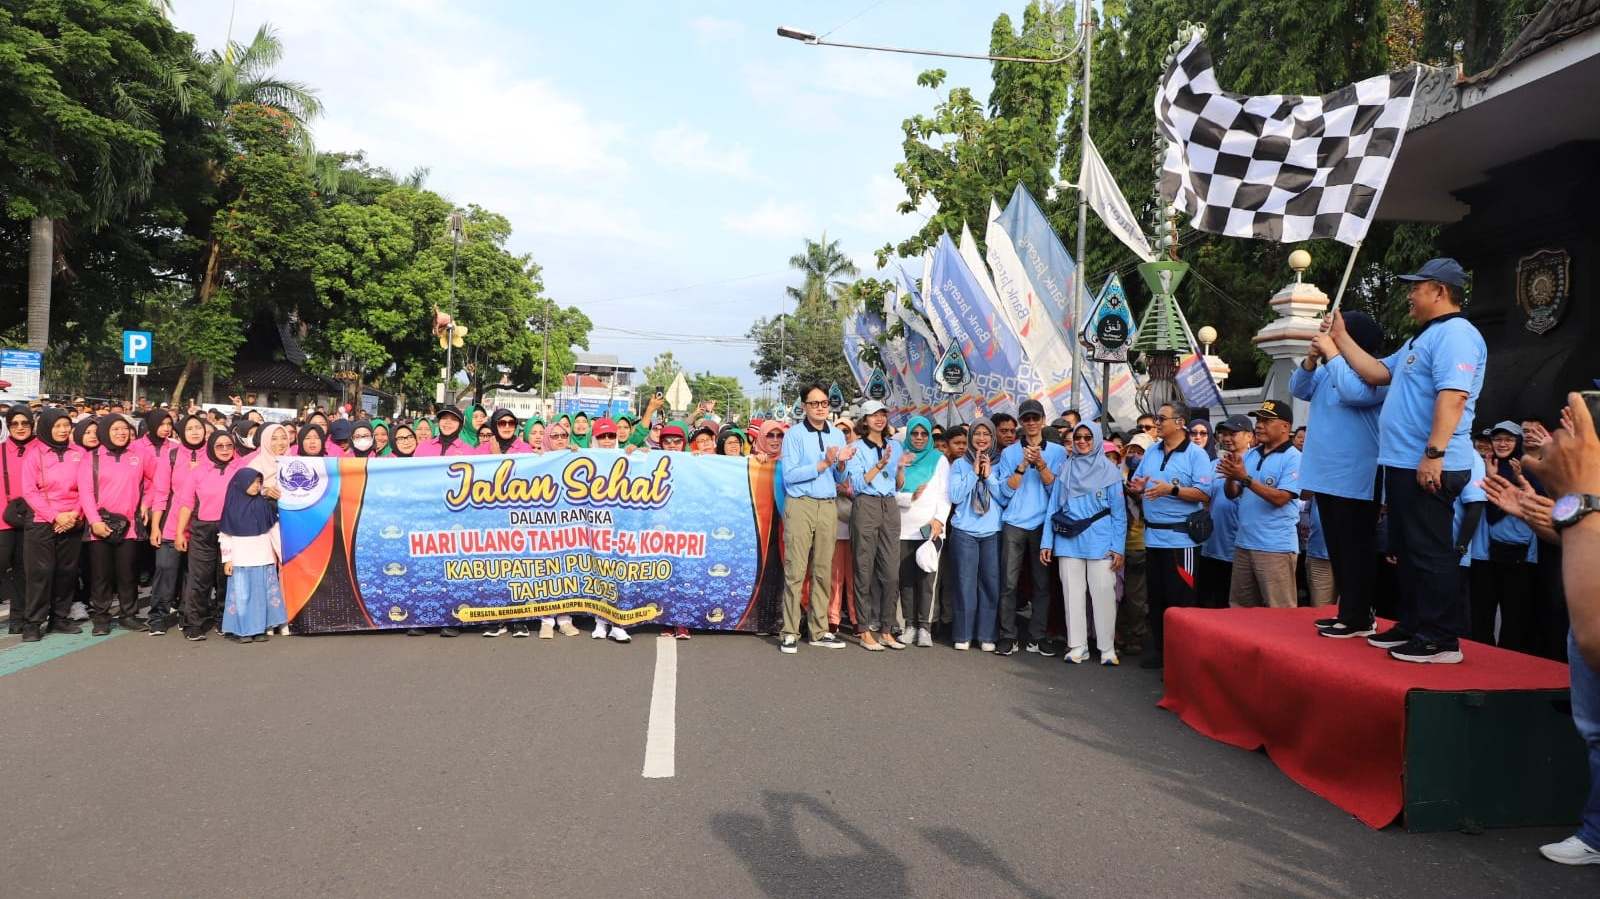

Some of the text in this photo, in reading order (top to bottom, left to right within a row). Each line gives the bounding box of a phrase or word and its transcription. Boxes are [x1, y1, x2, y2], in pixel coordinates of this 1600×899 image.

[129, 334, 148, 359] P
[445, 455, 672, 508] Jalan Sehat
[510, 508, 612, 525] DALAM RANGKA
[411, 527, 705, 557] HARI ULANG TAHUN KE-54 KORPRI
[445, 554, 672, 582] KABUPATEN PUWOREJO
[509, 575, 618, 601] TAHUN 2025
[533, 603, 561, 613] BERSAMA
[562, 601, 583, 609] KORPRI
